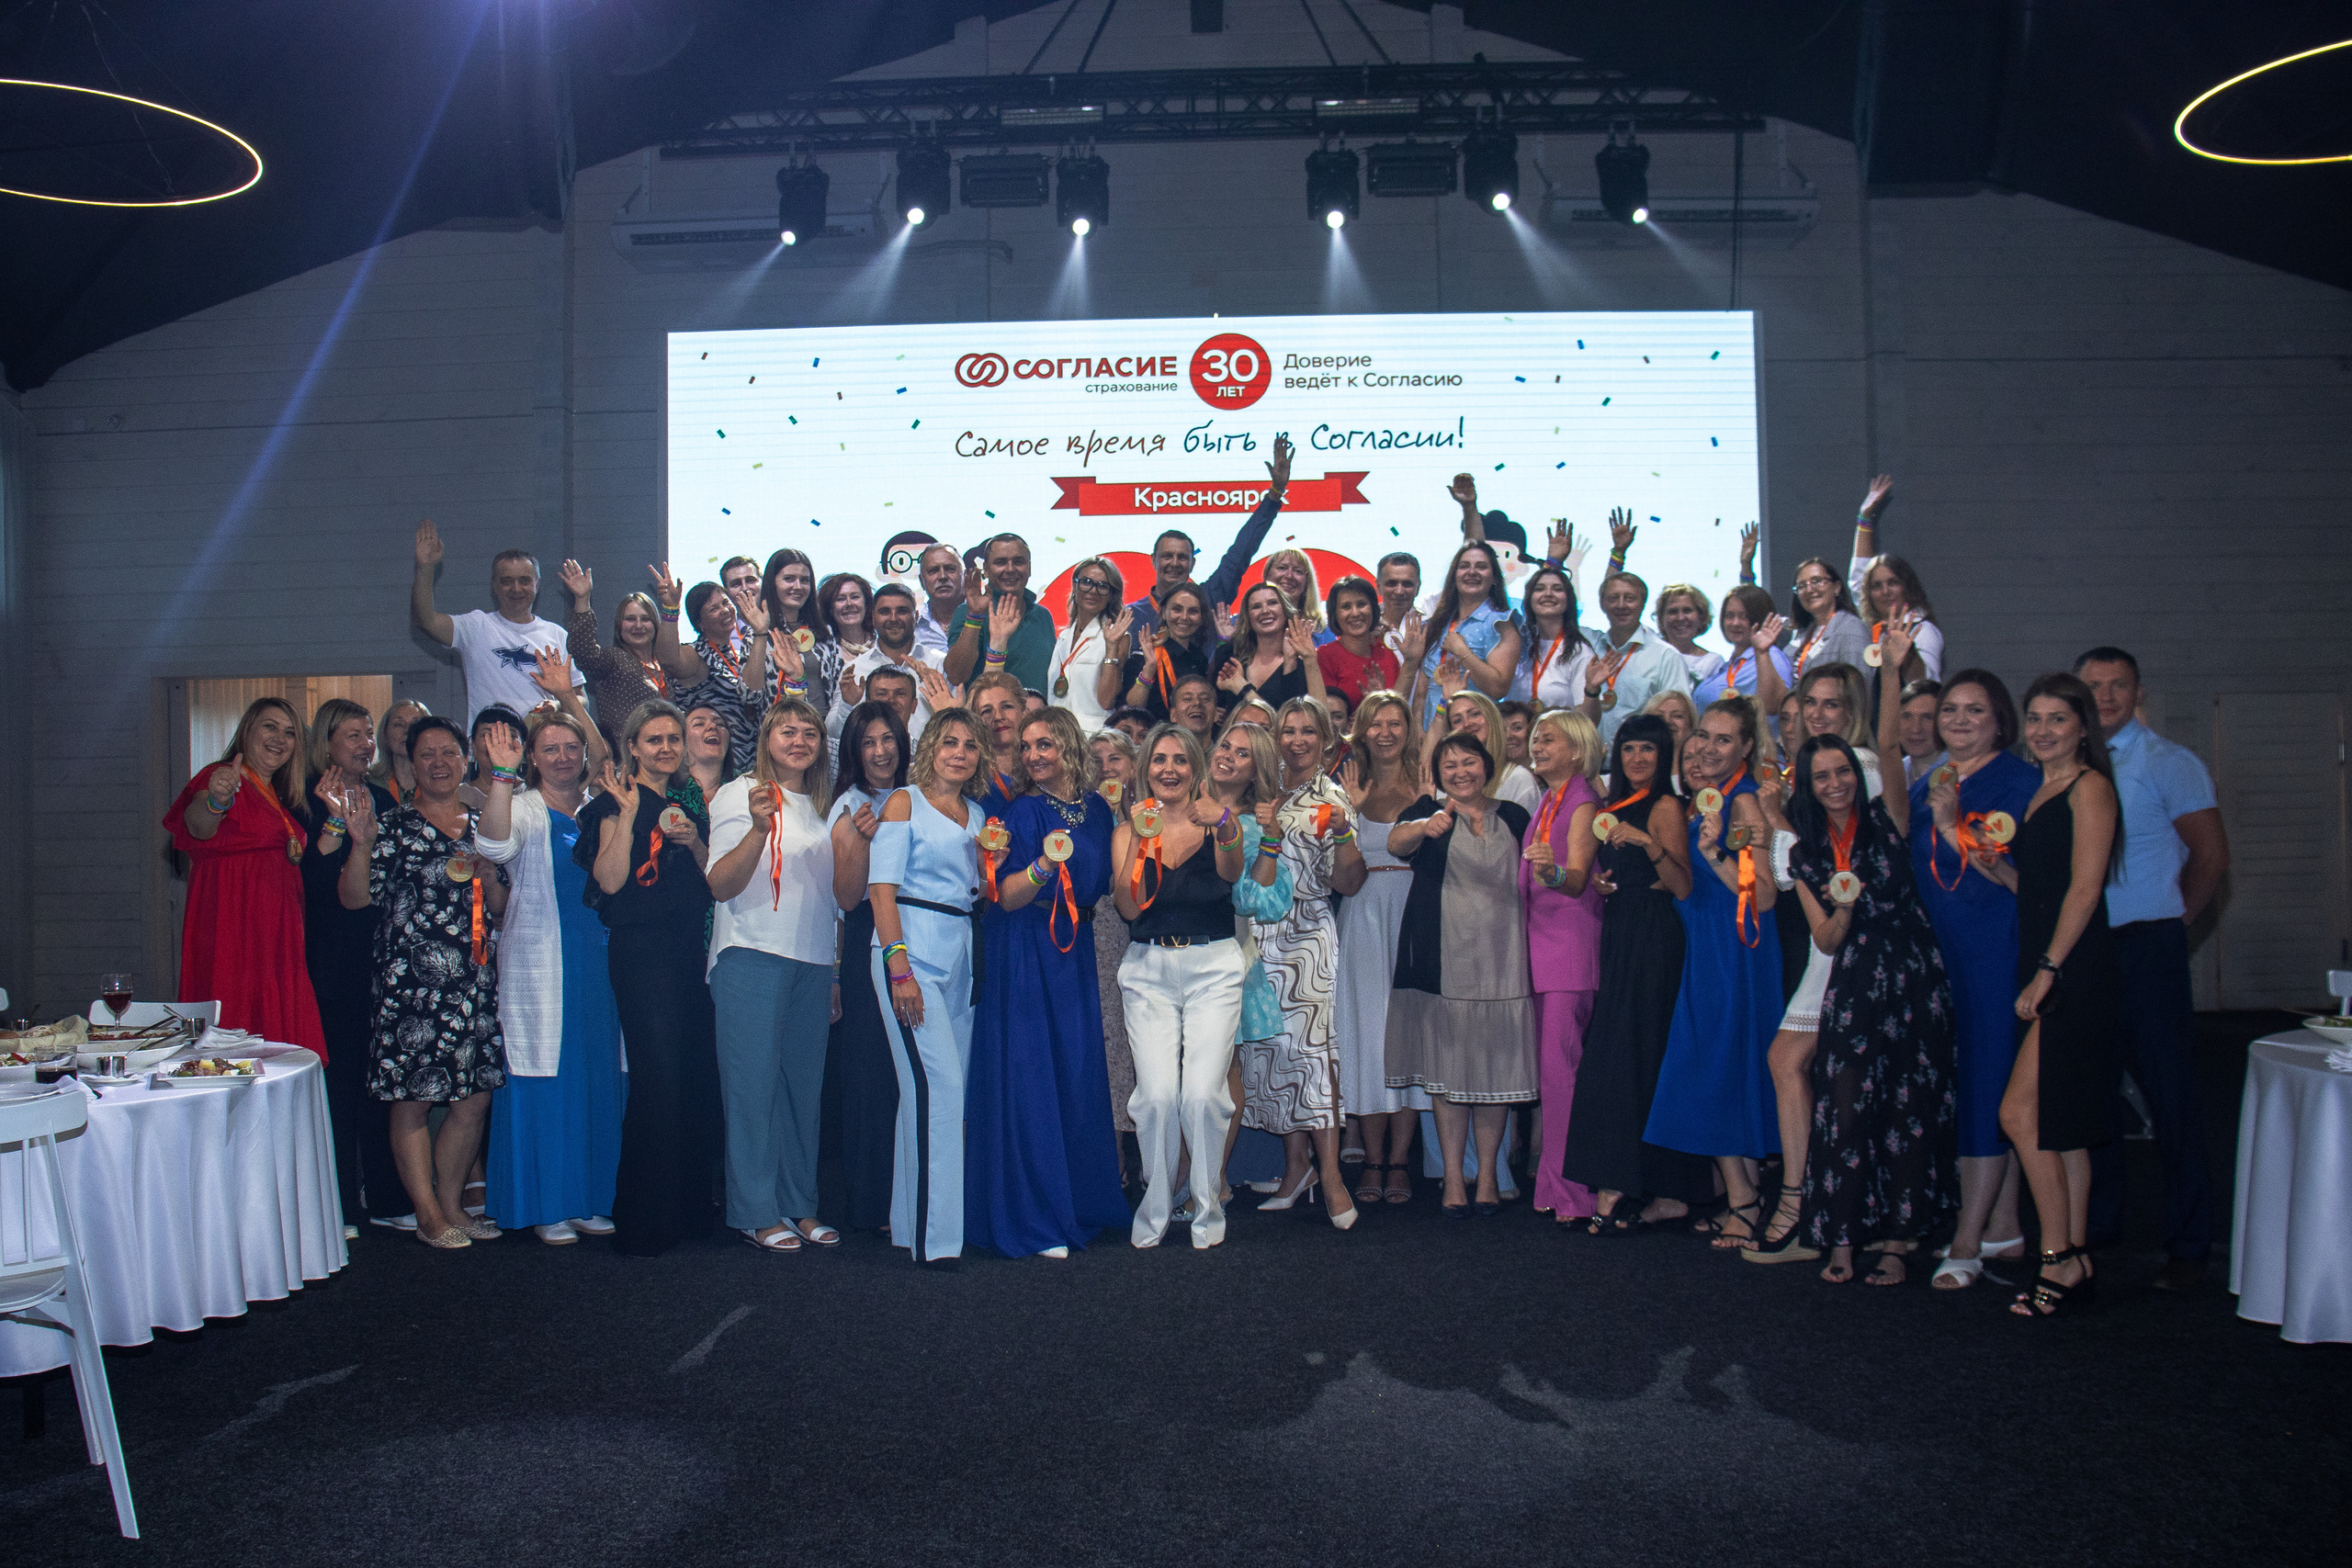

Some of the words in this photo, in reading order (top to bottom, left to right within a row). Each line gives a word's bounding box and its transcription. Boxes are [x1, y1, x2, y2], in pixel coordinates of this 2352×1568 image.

[1013, 356, 1178, 379] СОГЛАСИЕ
[1201, 348, 1260, 384] 30
[1283, 354, 1372, 370] Доверие
[1085, 381, 1178, 394] страхование
[1284, 373, 1341, 390] ведёт
[1348, 375, 1358, 387] к
[1363, 372, 1463, 387] Согласию
[1216, 386, 1246, 398] ЛЕТ
[956, 431, 1050, 457] Самое
[1066, 429, 1166, 468] время
[1183, 420, 1257, 453] быть
[1310, 415, 1464, 450] Согласии!
